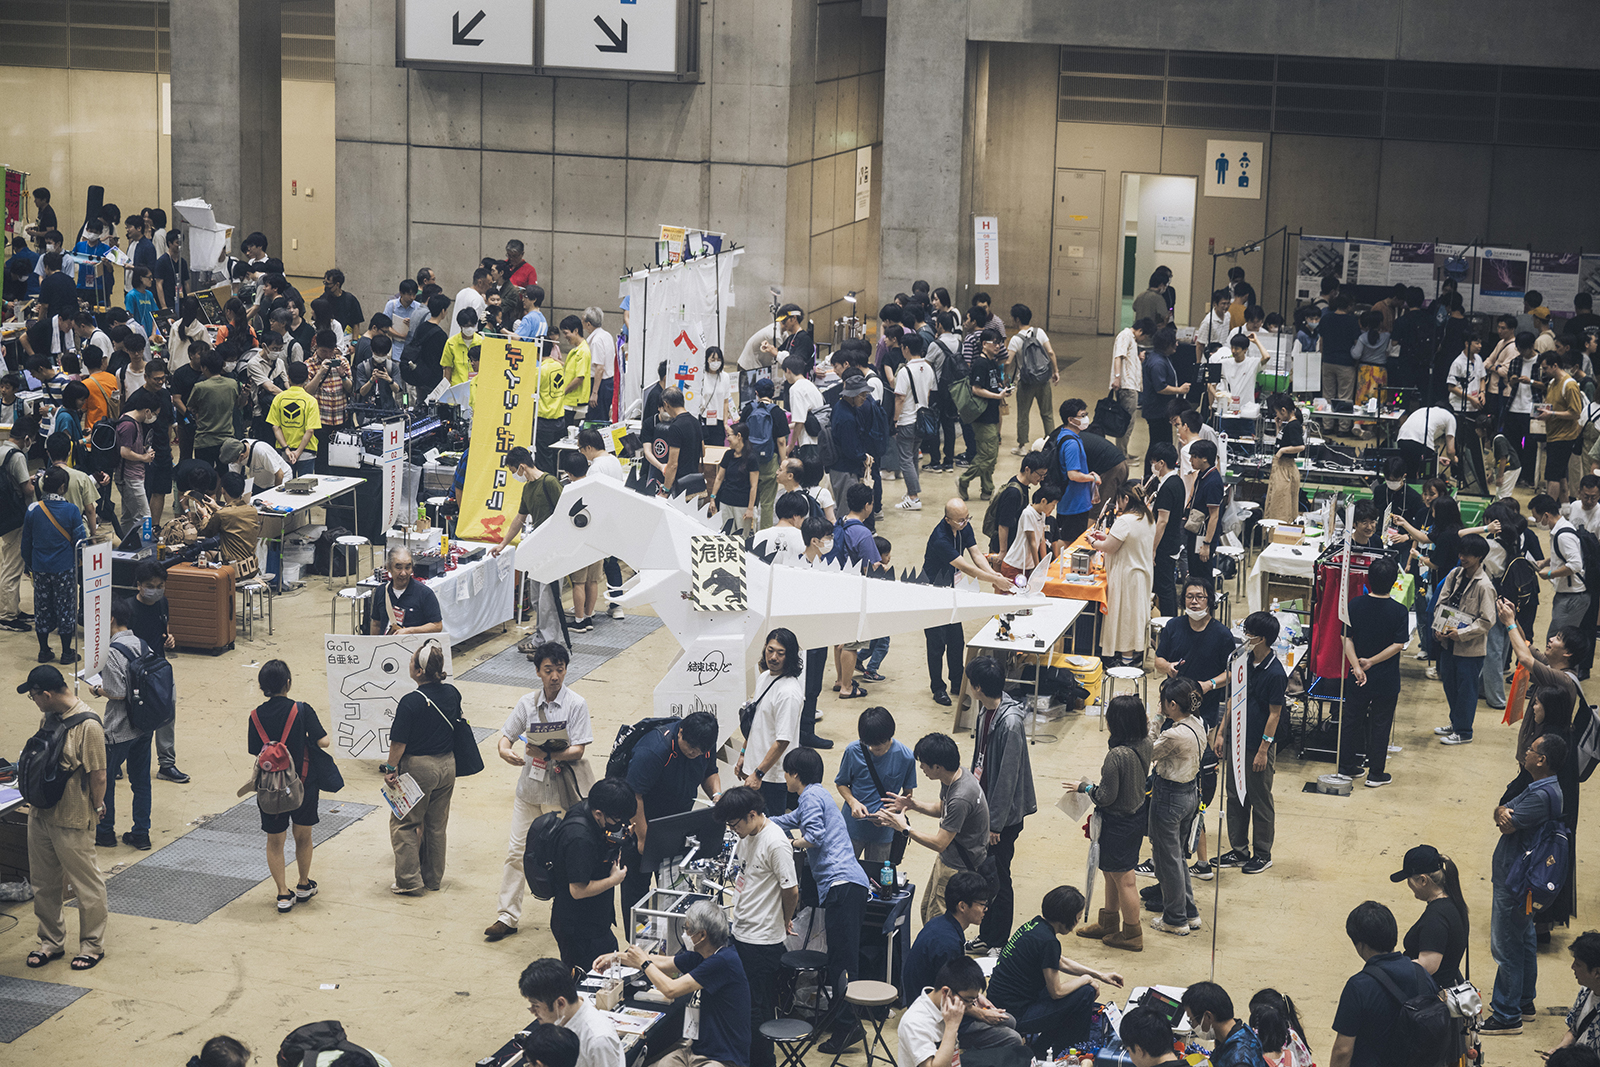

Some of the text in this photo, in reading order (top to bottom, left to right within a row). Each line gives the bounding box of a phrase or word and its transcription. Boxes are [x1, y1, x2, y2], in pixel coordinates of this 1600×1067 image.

[982, 221, 990, 230] H
[390, 430, 398, 445] H
[391, 451, 398, 459] 02
[388, 465, 396, 525] ELECTRONICS
[699, 543, 738, 563] 危険
[93, 553, 103, 571] H
[94, 579, 102, 588] 01
[93, 595, 101, 669] ELECTRONICS
[326, 640, 355, 652] GoTo
[327, 653, 360, 665] 白亜紀
[1237, 665, 1243, 684] G
